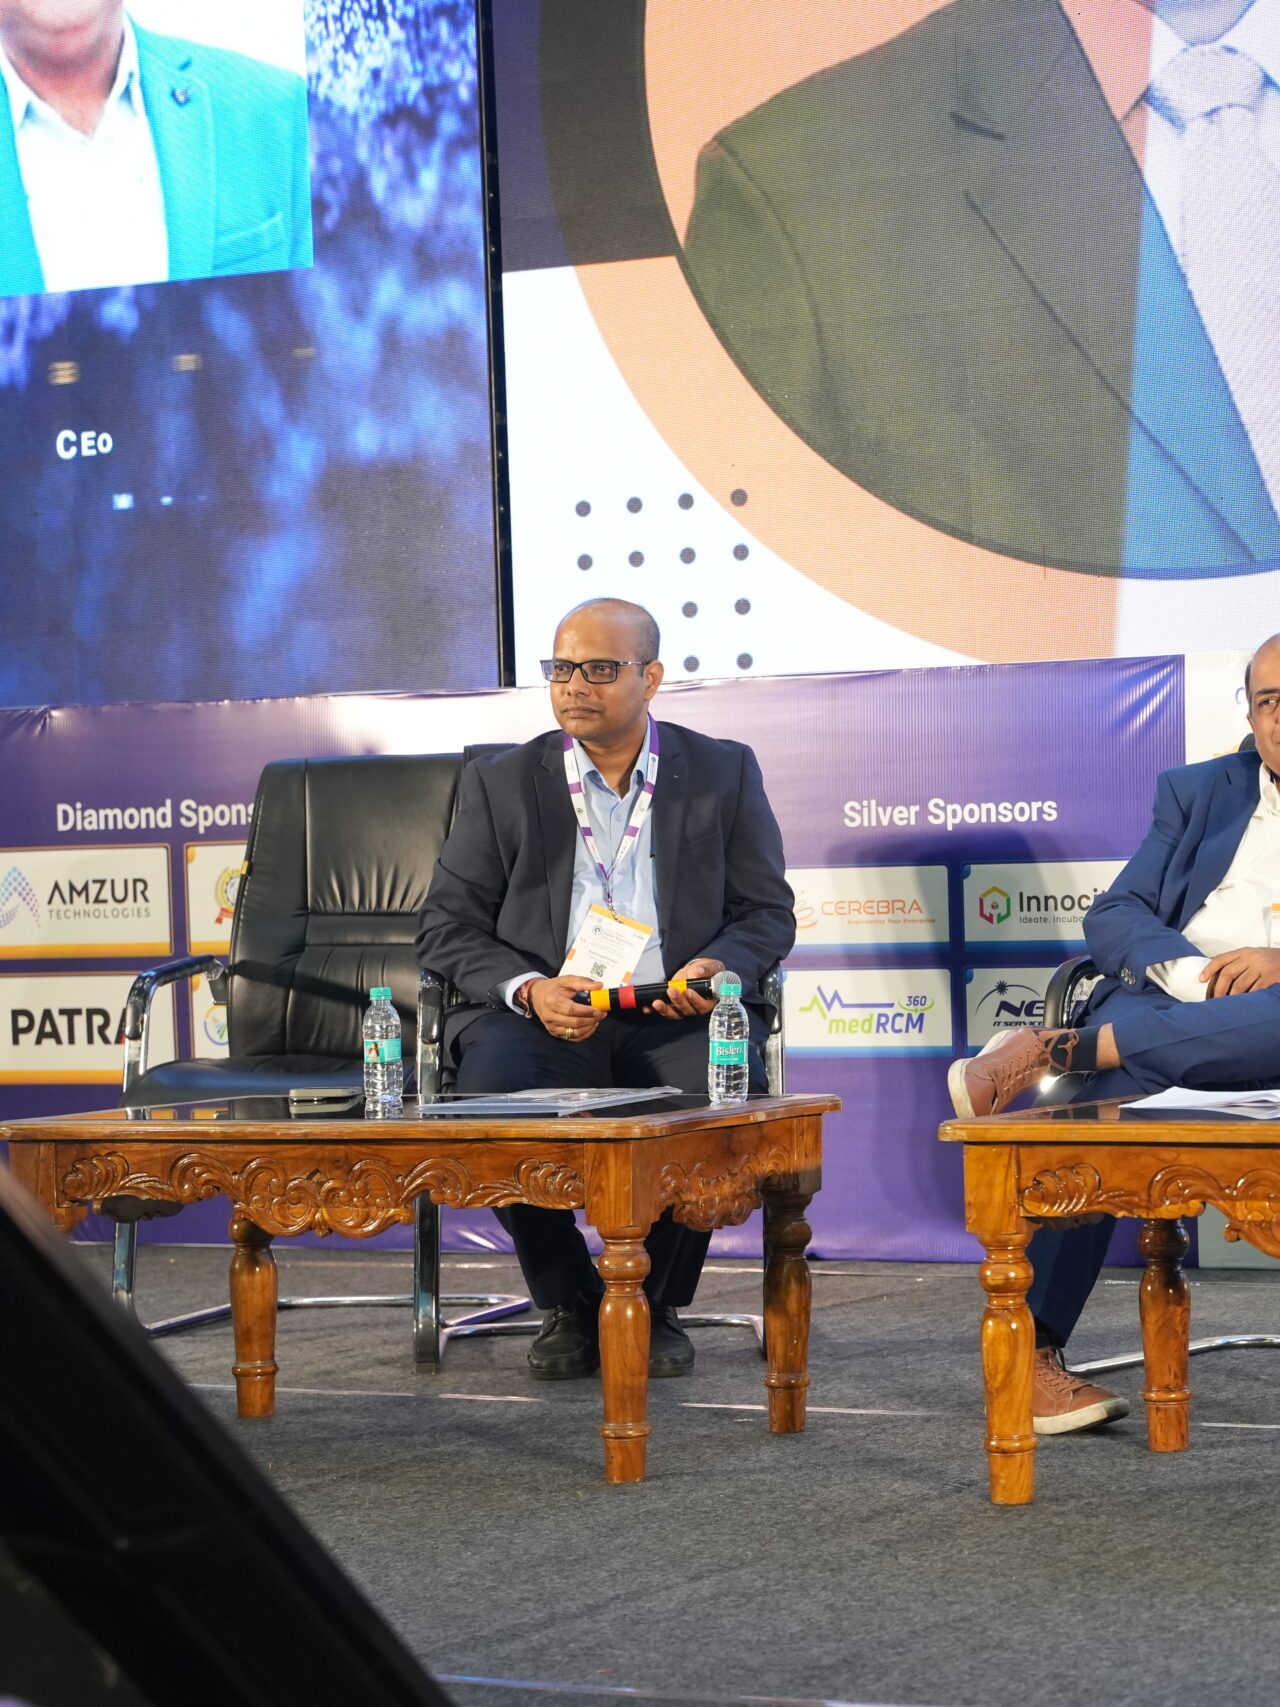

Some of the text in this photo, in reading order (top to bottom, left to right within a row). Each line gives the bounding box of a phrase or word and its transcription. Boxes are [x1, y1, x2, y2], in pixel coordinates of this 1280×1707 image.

[56, 798, 172, 832] Diamond
[843, 798, 1058, 831] Silver Sponsors
[47, 878, 150, 905] AMZUR
[1019, 888, 1098, 912] Innoc
[47, 907, 152, 920] TECHNOLOGIES
[821, 898, 924, 916] CEREBRA
[905, 995, 928, 1007] 360
[828, 1012, 925, 1034] medRCM
